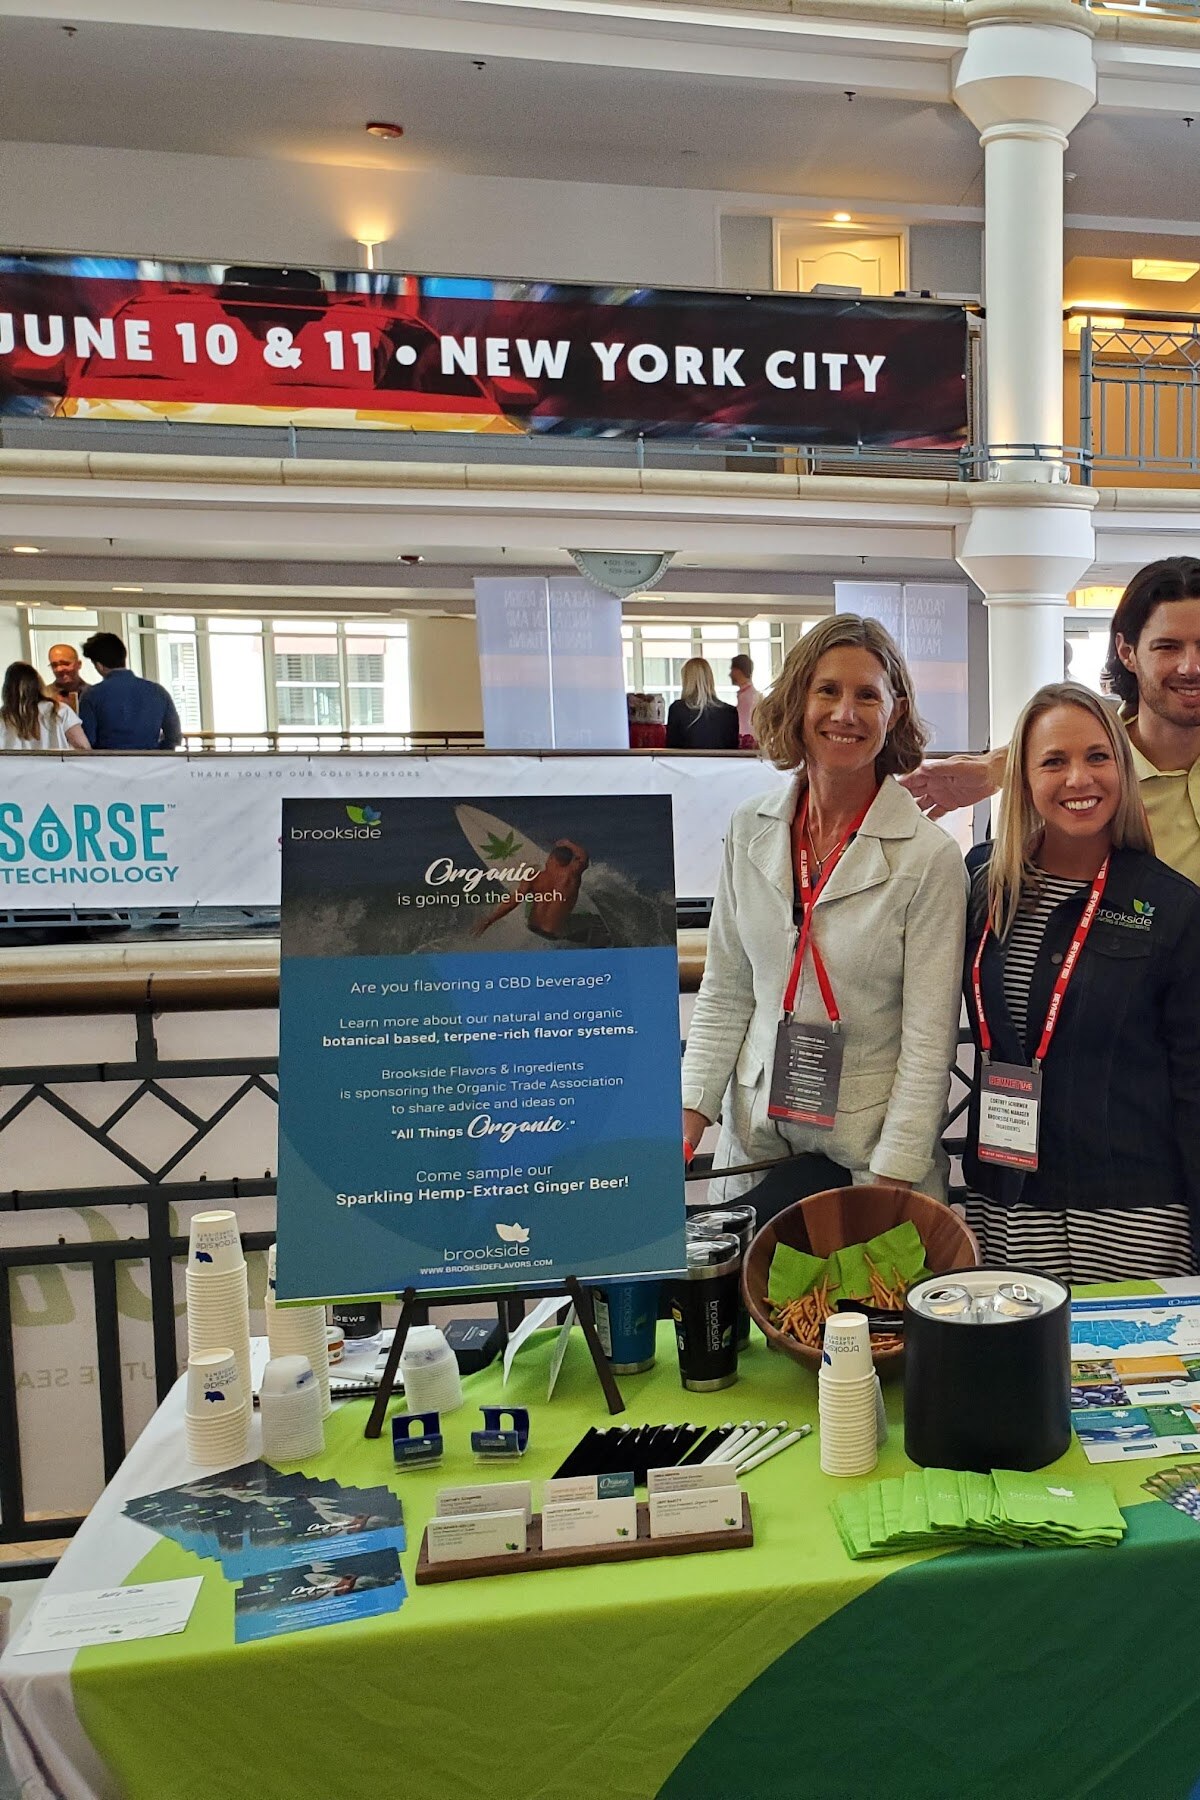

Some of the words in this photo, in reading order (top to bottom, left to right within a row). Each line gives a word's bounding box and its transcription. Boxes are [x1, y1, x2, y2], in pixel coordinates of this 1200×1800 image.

[0, 312, 154, 363] JUNE
[175, 320, 239, 367] 10
[262, 325, 304, 370] &
[323, 329, 374, 373] 11
[441, 335, 571, 381] NEW
[597, 341, 747, 388] YORK
[764, 348, 889, 394] CITY
[190, 770, 230, 778] THANK
[268, 770, 283, 778] TO
[289, 770, 314, 778] OUR
[320, 770, 353, 778] GOLD
[357, 770, 421, 778] SPONSORS
[292, 826, 381, 839] brookside
[0, 865, 179, 884] TECHNOLOGY
[425, 858, 540, 892] Organic
[398, 893, 410, 905] is
[416, 892, 459, 907] going
[465, 893, 480, 903] to
[486, 891, 510, 903] the
[515, 889, 565, 902] beach.
[351, 983, 376, 993] Are
[381, 984, 408, 995] you
[414, 980, 479, 992] flavoring
[485, 981, 493, 989] a
[499, 977, 530, 988] CBD
[537, 974, 611, 988] beverage?
[340, 1019, 378, 1028] Learn
[384, 1018, 419, 1026] more
[424, 1015, 462, 1025] about
[467, 1016, 488, 1024] our
[494, 1011, 539, 1022] natural
[545, 1010, 568, 1020] and
[574, 1008, 622, 1021] organic
[323, 1034, 389, 1046] botanical
[394, 1032, 439, 1043] based,
[444, 1028, 529, 1043] terpene-rich
[534, 1028, 573, 1038] flavor
[578, 1026, 637, 1038] systems.
[382, 1067, 446, 1079] Brookside
[450, 1066, 496, 1076] Flavors
[501, 1064, 509, 1074] &
[514, 1062, 583, 1075] Ingredients
[341, 1091, 350, 1099] is
[356, 1088, 428, 1100] sponsoring
[433, 1085, 453, 1094] the
[457, 1084, 506, 1095] Organic
[510, 1080, 546, 1090] Trade
[550, 1078, 623, 1088] Association
[392, 1106, 404, 1114] to
[409, 1103, 444, 1113] share
[449, 1100, 490, 1111] advice
[494, 1098, 517, 1109] and
[522, 1097, 555, 1107] ideas
[418, 1127, 463, 1139] Things
[417, 1171, 461, 1182] Come
[467, 1166, 522, 1179] sample
[528, 1166, 552, 1175] our
[337, 1190, 412, 1207] Sparkling
[419, 1184, 528, 1200] Hemp-Extract
[534, 1181, 585, 1194] Ginger
[590, 1176, 628, 1189] Beer!
[444, 1244, 529, 1260] brookside
[419, 1258, 553, 1276] WWW.BROOKSIDEFLAVORS.COM
[709, 1299, 721, 1352] brookside
